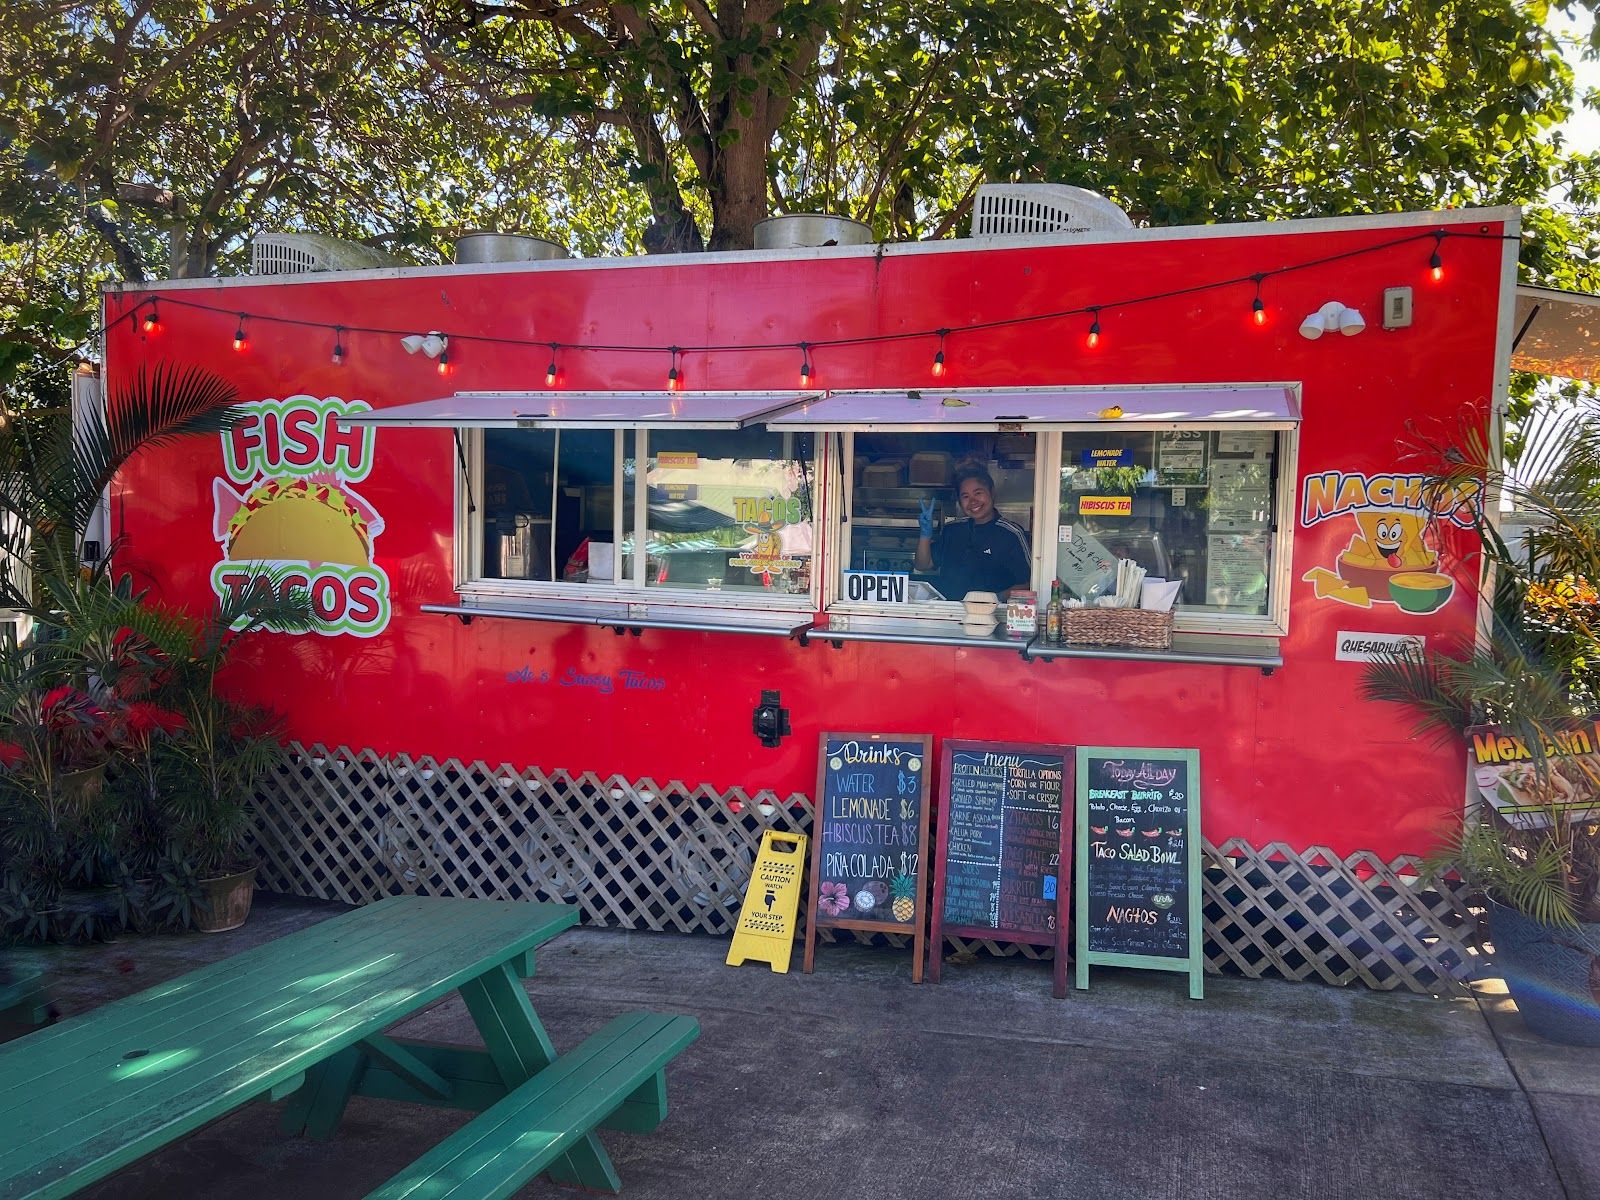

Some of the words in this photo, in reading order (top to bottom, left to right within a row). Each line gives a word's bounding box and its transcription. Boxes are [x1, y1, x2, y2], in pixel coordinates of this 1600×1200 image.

[230, 407, 364, 471] FISH
[1091, 448, 1124, 458] LEMONADE
[1096, 459, 1118, 467] WATER
[734, 497, 801, 525] TACOS
[1080, 500, 1116, 510] HIBISCUS
[1118, 501, 1131, 510] TEA
[848, 574, 904, 603] OPEN
[844, 741, 900, 766] Drinks
[1008, 767, 1036, 779] TORTILLA
[1038, 769, 1062, 780] OPTIONS
[836, 773, 875, 793] WATER
[897, 769, 917, 794] $3
[1009, 779, 1027, 789] CORN
[1008, 790, 1028, 801] SOFT
[1036, 793, 1060, 804] CRISPY
[832, 796, 893, 820] LEMONADE
[900, 799, 915, 820] $6
[1047, 815, 1059, 830] 16
[1113, 814, 1136, 824] Bacon
[823, 822, 873, 845] HIBISCUS
[874, 824, 900, 846] TEA
[901, 822, 918, 846] $8
[826, 852, 849, 878] PIÑA
[850, 853, 895, 879] COLADA
[900, 851, 919, 876] $12
[1048, 853, 1060, 866] 22
[760, 874, 791, 884] CAUTION
[1044, 880, 1056, 894] 20
[751, 911, 768, 919] YOUR
